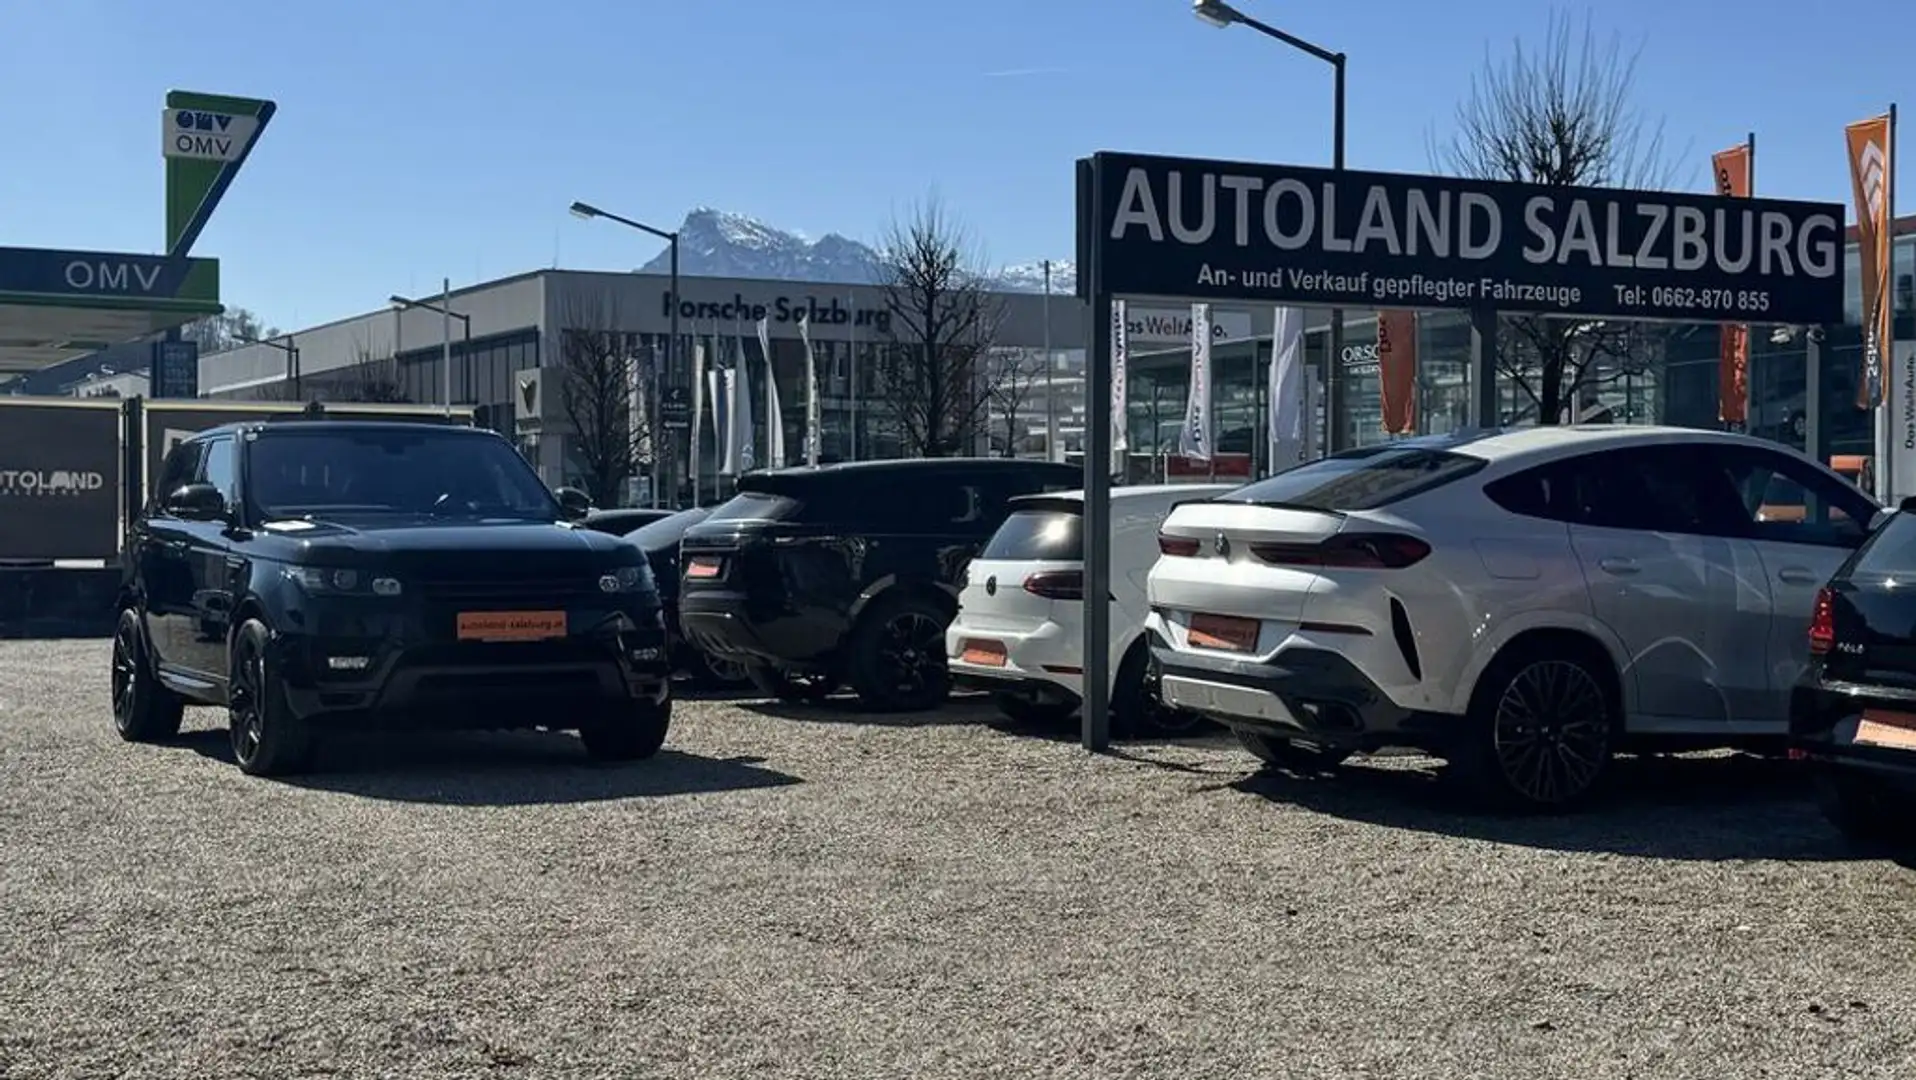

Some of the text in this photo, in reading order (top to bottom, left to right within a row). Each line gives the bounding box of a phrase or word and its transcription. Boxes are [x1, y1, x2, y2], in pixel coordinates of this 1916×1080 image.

[175, 136, 232, 156] OMV
[1110, 167, 1837, 278] AUTOLAND SALZBURG
[65, 260, 162, 291] OMV
[1197, 262, 1581, 306] An- und Verkauf gepflegter Fahrzeuge
[1613, 284, 1770, 311] Tel: 0662-870 855
[662, 292, 891, 333] Porsche Salzburg
[1126, 320, 1143, 334] as
[0, 470, 104, 489] TOLAND
